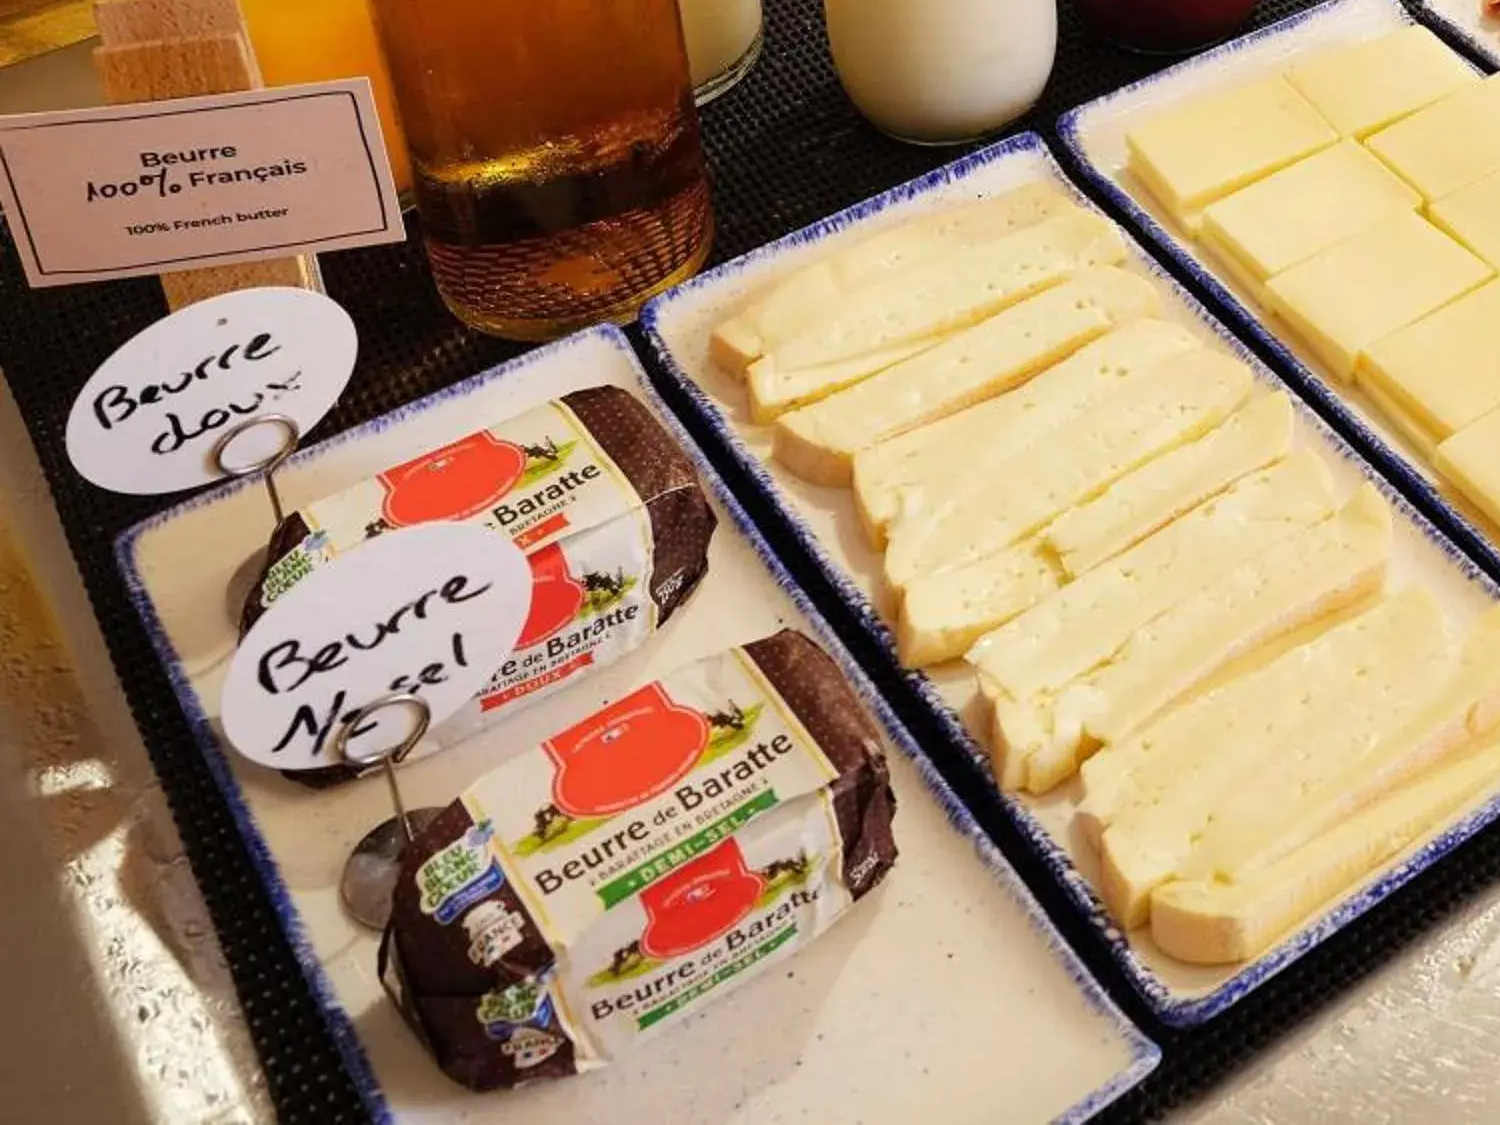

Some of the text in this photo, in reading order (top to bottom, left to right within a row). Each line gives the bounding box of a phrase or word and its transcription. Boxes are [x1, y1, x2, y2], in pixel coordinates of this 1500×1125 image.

[86, 159, 307, 203] 100% Français
[140, 143, 238, 168] Beurre
[124, 205, 289, 237] 100% French butter
[93, 331, 281, 429] Beurre
[151, 370, 303, 455] doux
[492, 463, 601, 526] Baratte
[258, 573, 494, 694] Beurre
[390, 633, 469, 696] sel
[523, 603, 639, 667] de Baratte
[514, 670, 562, 697] DOUX
[534, 818, 650, 896] Beurre
[653, 804, 679, 826] de
[675, 733, 793, 811] Baratte
[675, 821, 692, 836] EN
[640, 818, 745, 881] DEMI-SEL
[591, 961, 696, 1021] Beurre
[701, 947, 722, 966] de
